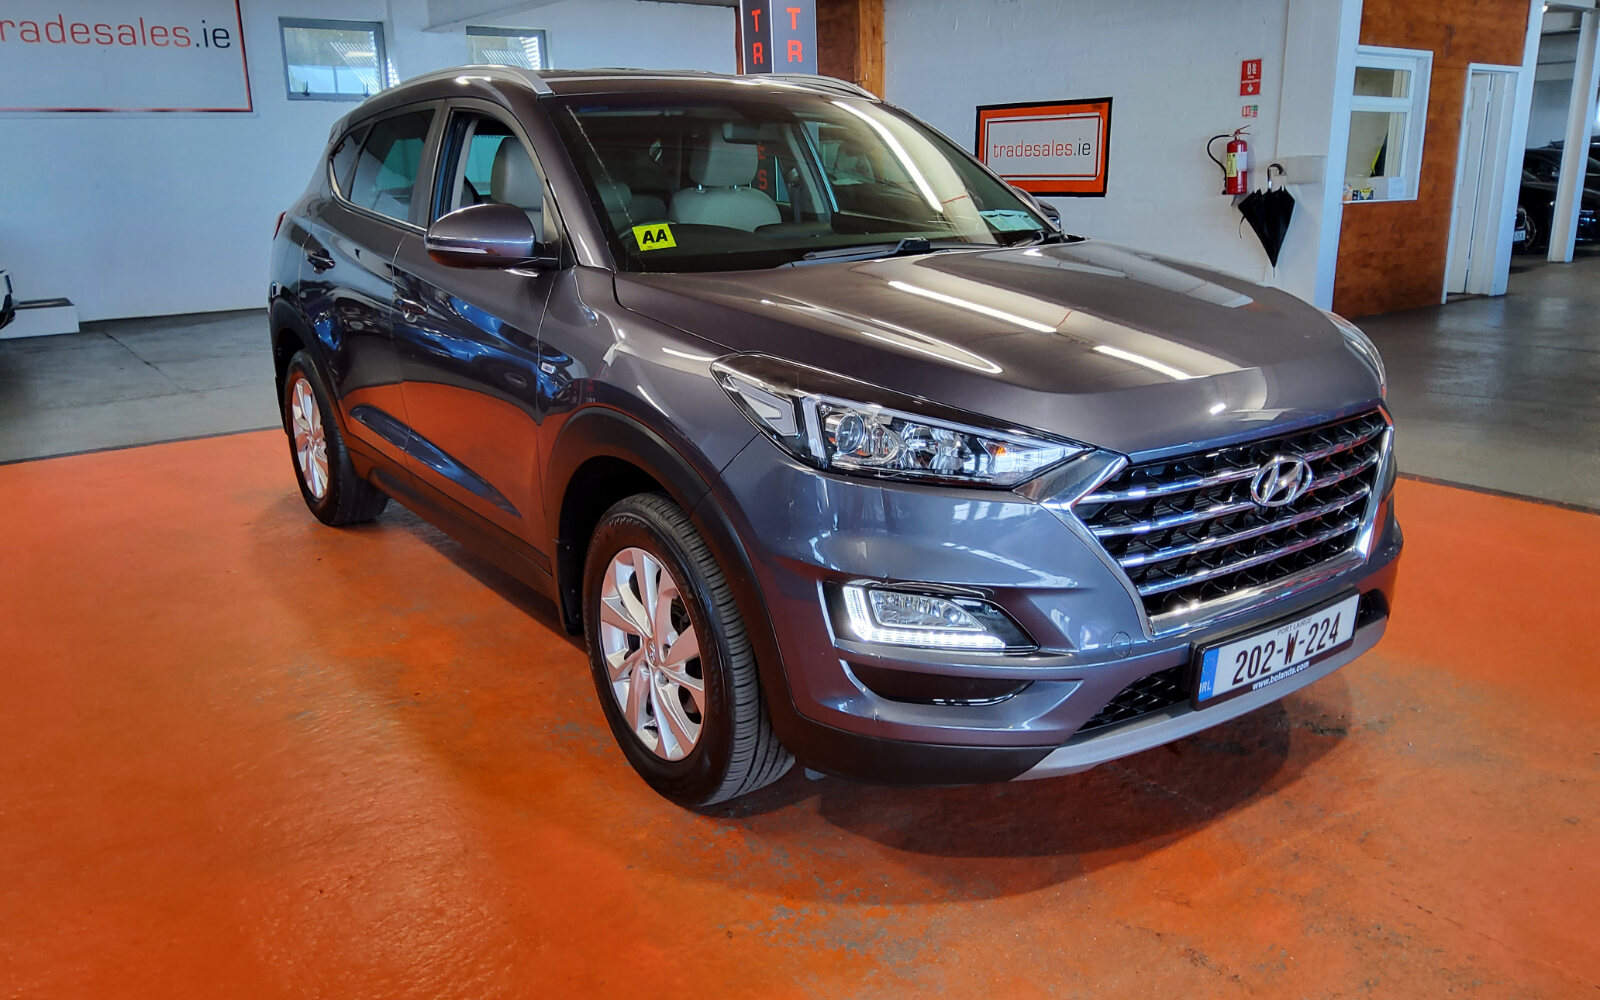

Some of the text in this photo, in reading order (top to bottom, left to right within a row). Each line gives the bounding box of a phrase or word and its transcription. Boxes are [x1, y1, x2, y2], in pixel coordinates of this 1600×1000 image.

[993, 138, 1091, 158] tradesales.ie
[642, 229, 669, 244] AA
[1277, 625, 1293, 636] PORT
[1232, 612, 1341, 686] 202-W-224
[1252, 661, 1310, 690] www.bolands.com
[1199, 679, 1212, 693] IRL
